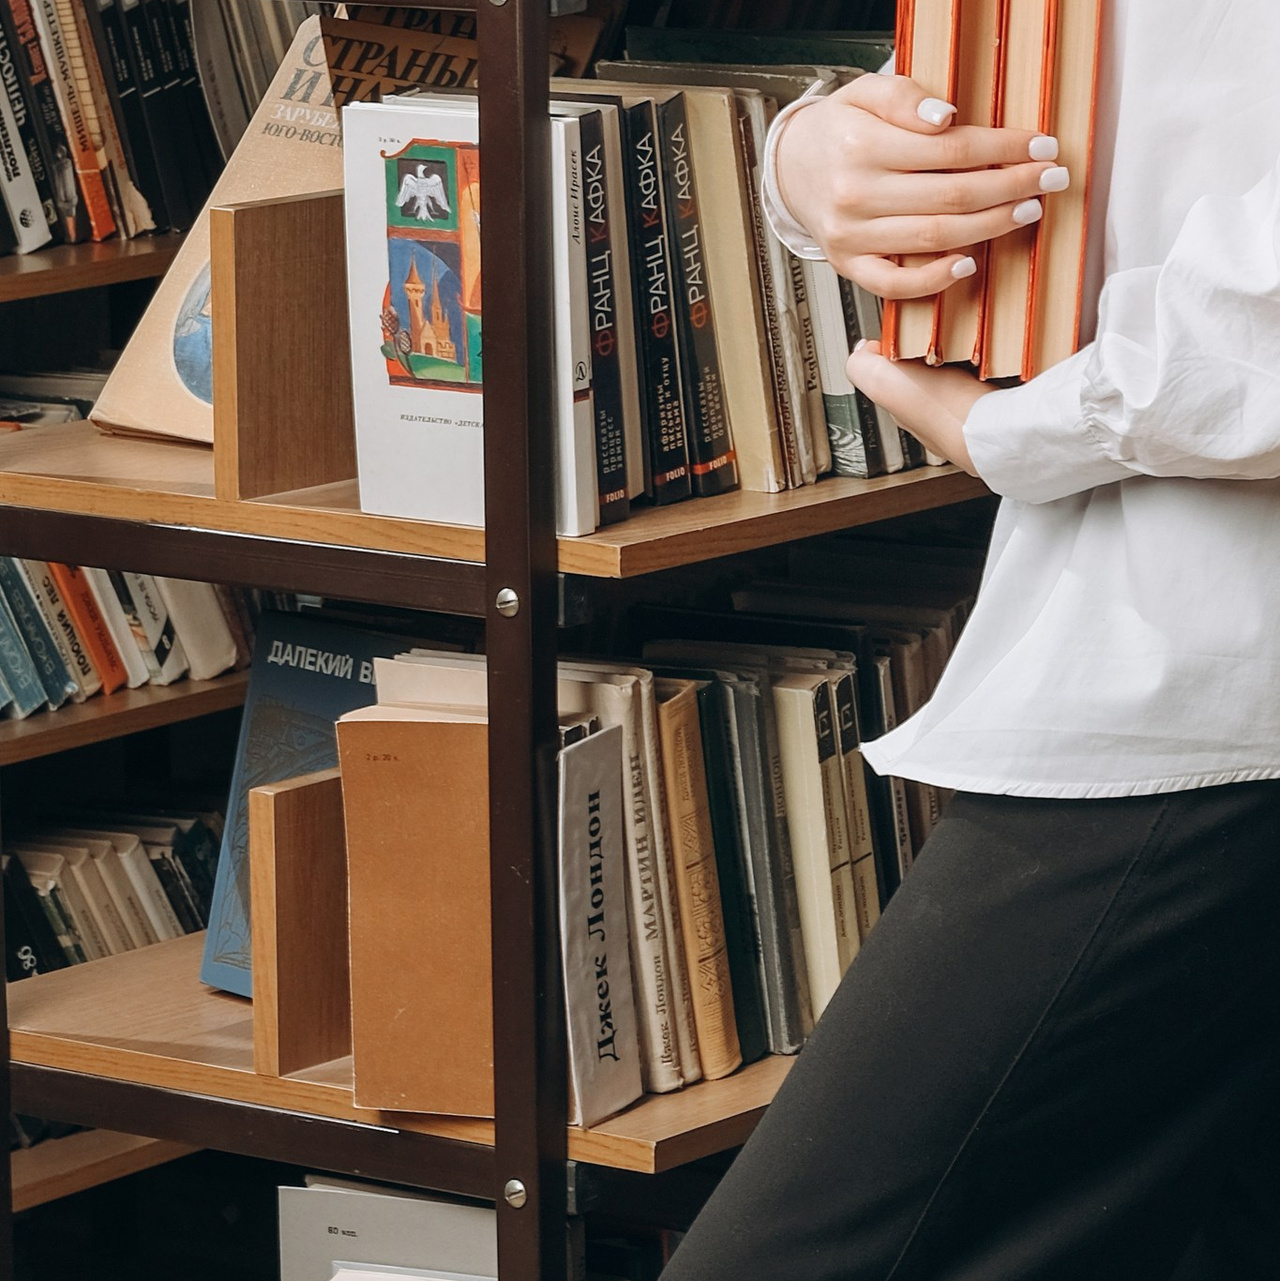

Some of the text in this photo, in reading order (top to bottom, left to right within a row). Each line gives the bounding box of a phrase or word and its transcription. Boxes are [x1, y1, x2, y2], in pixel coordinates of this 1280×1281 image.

[0, 20, 28, 127] ЧЕЛЮСТ
[280, 68, 326, 105] И
[303, 34, 478, 89] СТРАНЫ
[585, 144, 617, 356] ФРАНЦ КАФКА
[635, 131, 672, 338] ФРАНЦ КАФКА
[669, 123, 710, 329] ФРАНЦ КАФКА
[801, 316, 820, 392] Редьярд
[598, 409, 611, 475] рассказы
[606, 415, 618, 473] процесс
[665, 466, 687, 481] FOLIO
[708, 455, 729, 470] FOLIO
[605, 489, 626, 504] FOLIO
[42, 574, 61, 606] ЛЕС
[56, 608, 92, 677] ПОЮЩИЙ
[267, 640, 354, 680] ДАЛЕКИЙ
[628, 751, 647, 827] ИДЕН
[633, 834, 660, 942] МАРТИН
[585, 789, 621, 1062] Джек Лондон
[652, 954, 668, 1016] Лондон
